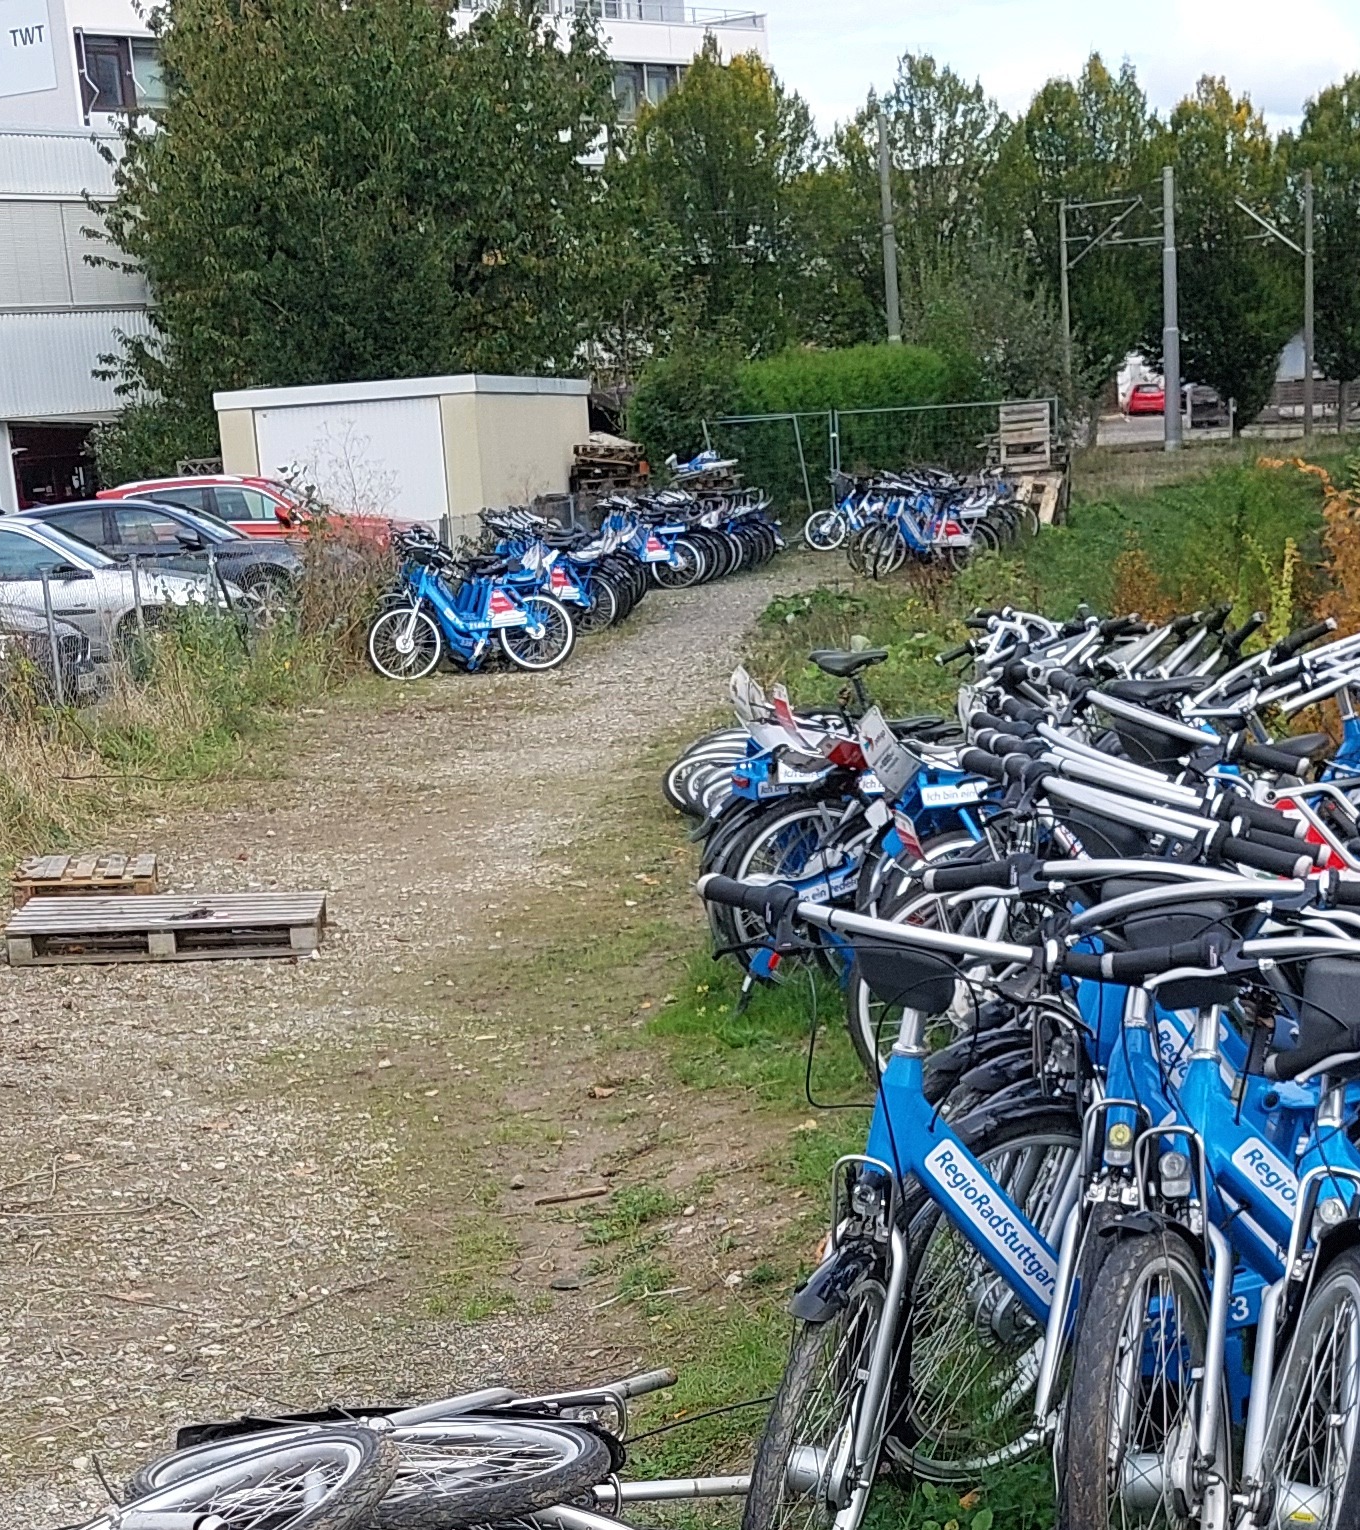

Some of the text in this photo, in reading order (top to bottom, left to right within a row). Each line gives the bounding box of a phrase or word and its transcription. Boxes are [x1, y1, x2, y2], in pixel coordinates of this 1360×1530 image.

[9, 24, 45, 47] TWT
[926, 789, 941, 801] Ich
[942, 787, 959, 800] bin
[1242, 1148, 1298, 1207] Regio
